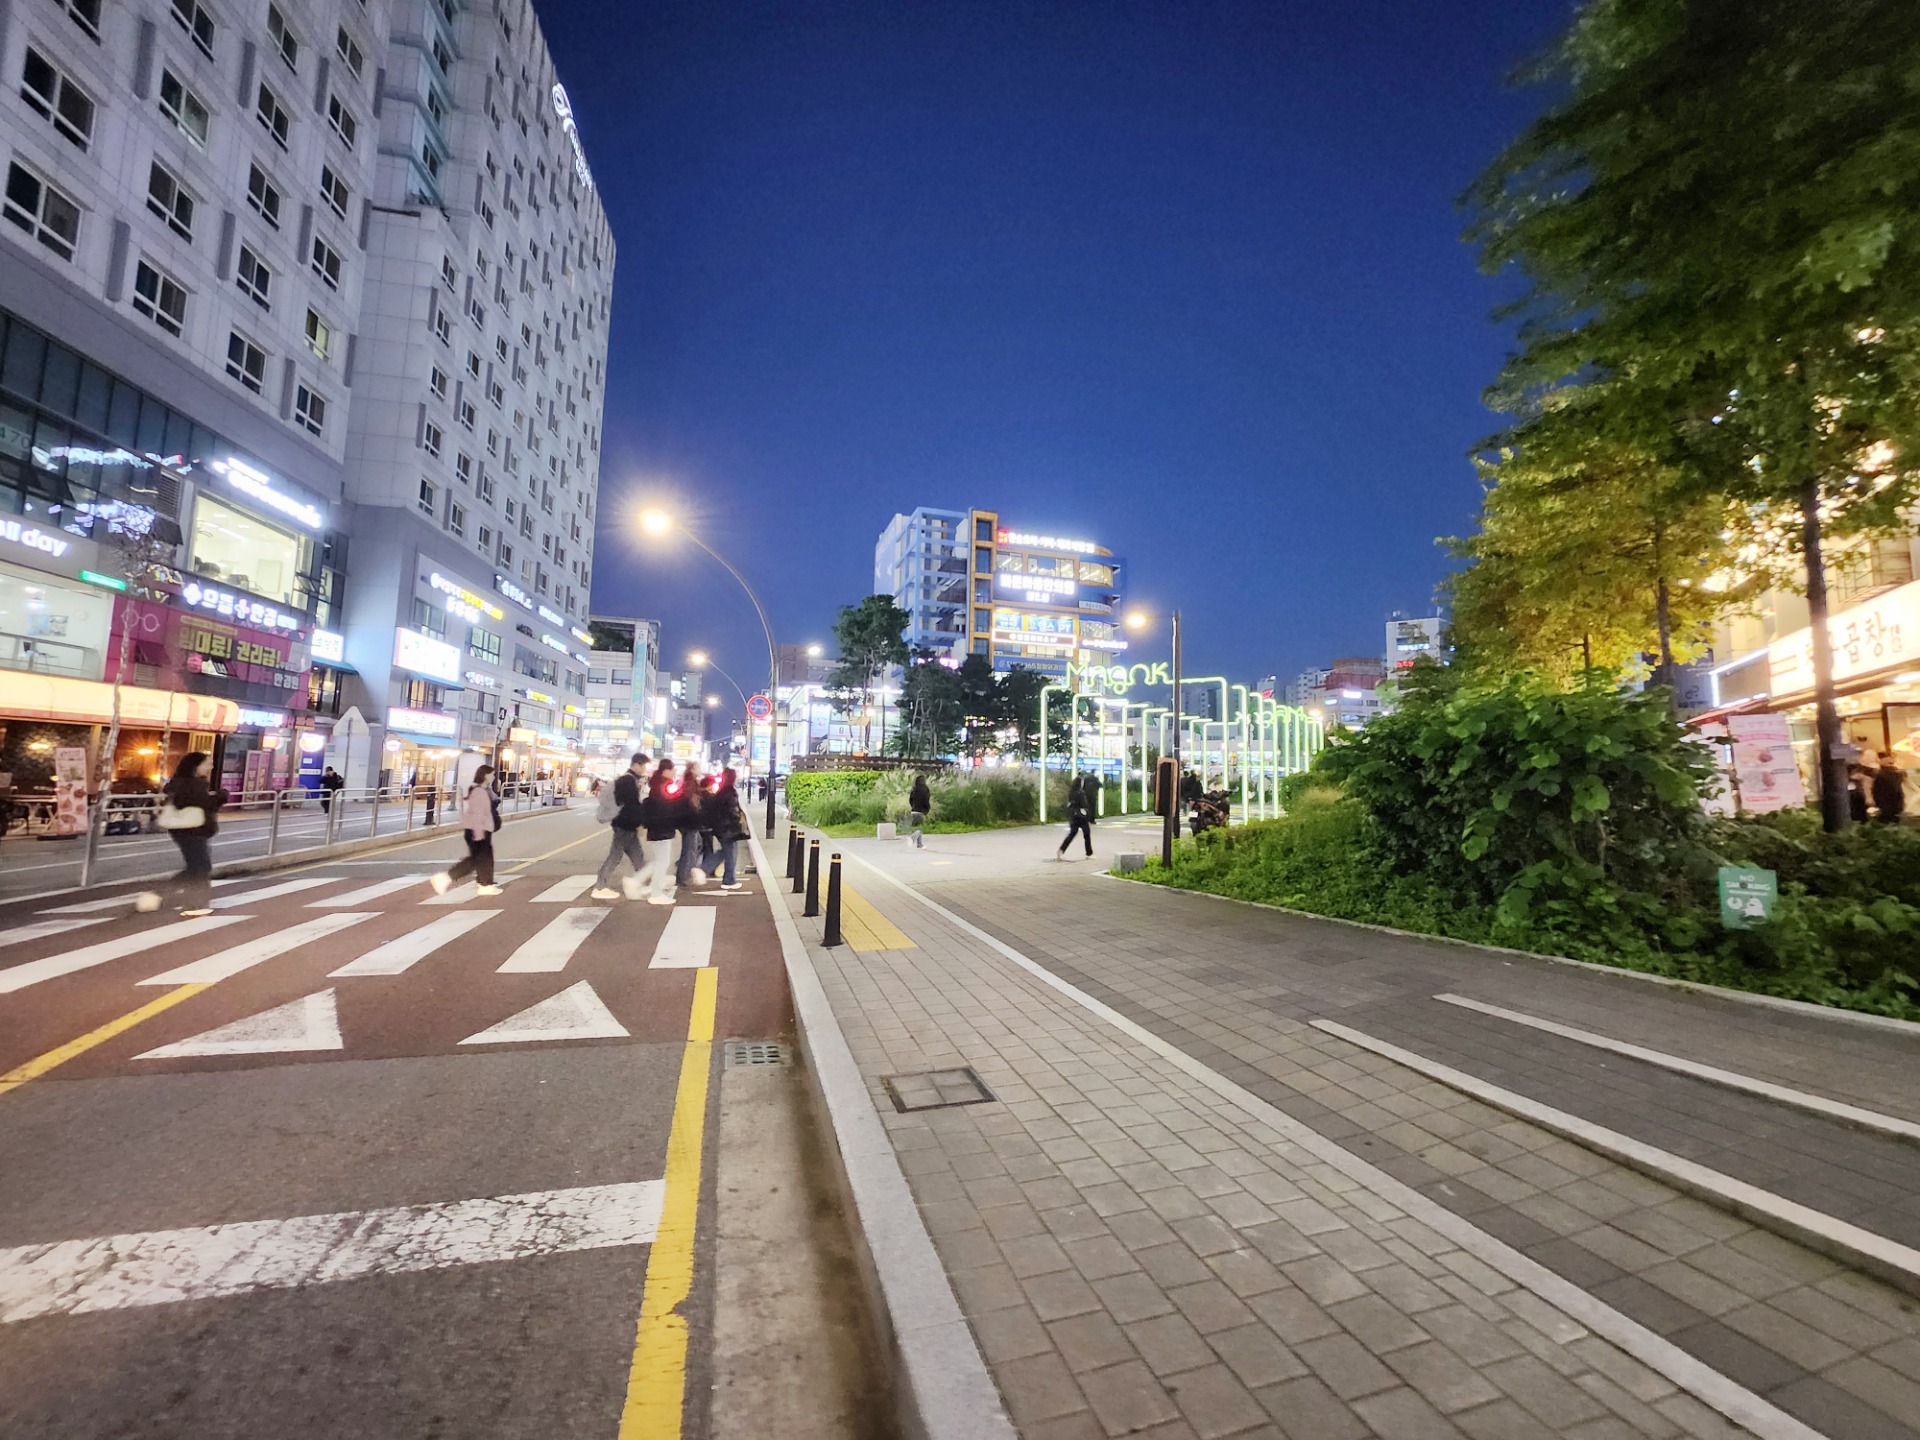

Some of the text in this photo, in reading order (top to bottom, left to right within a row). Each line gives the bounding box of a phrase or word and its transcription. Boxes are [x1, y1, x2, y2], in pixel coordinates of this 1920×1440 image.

[21, 528, 69, 557] day
[178, 627, 232, 659] 임대료!
[237, 640, 282, 669] 권리금!
